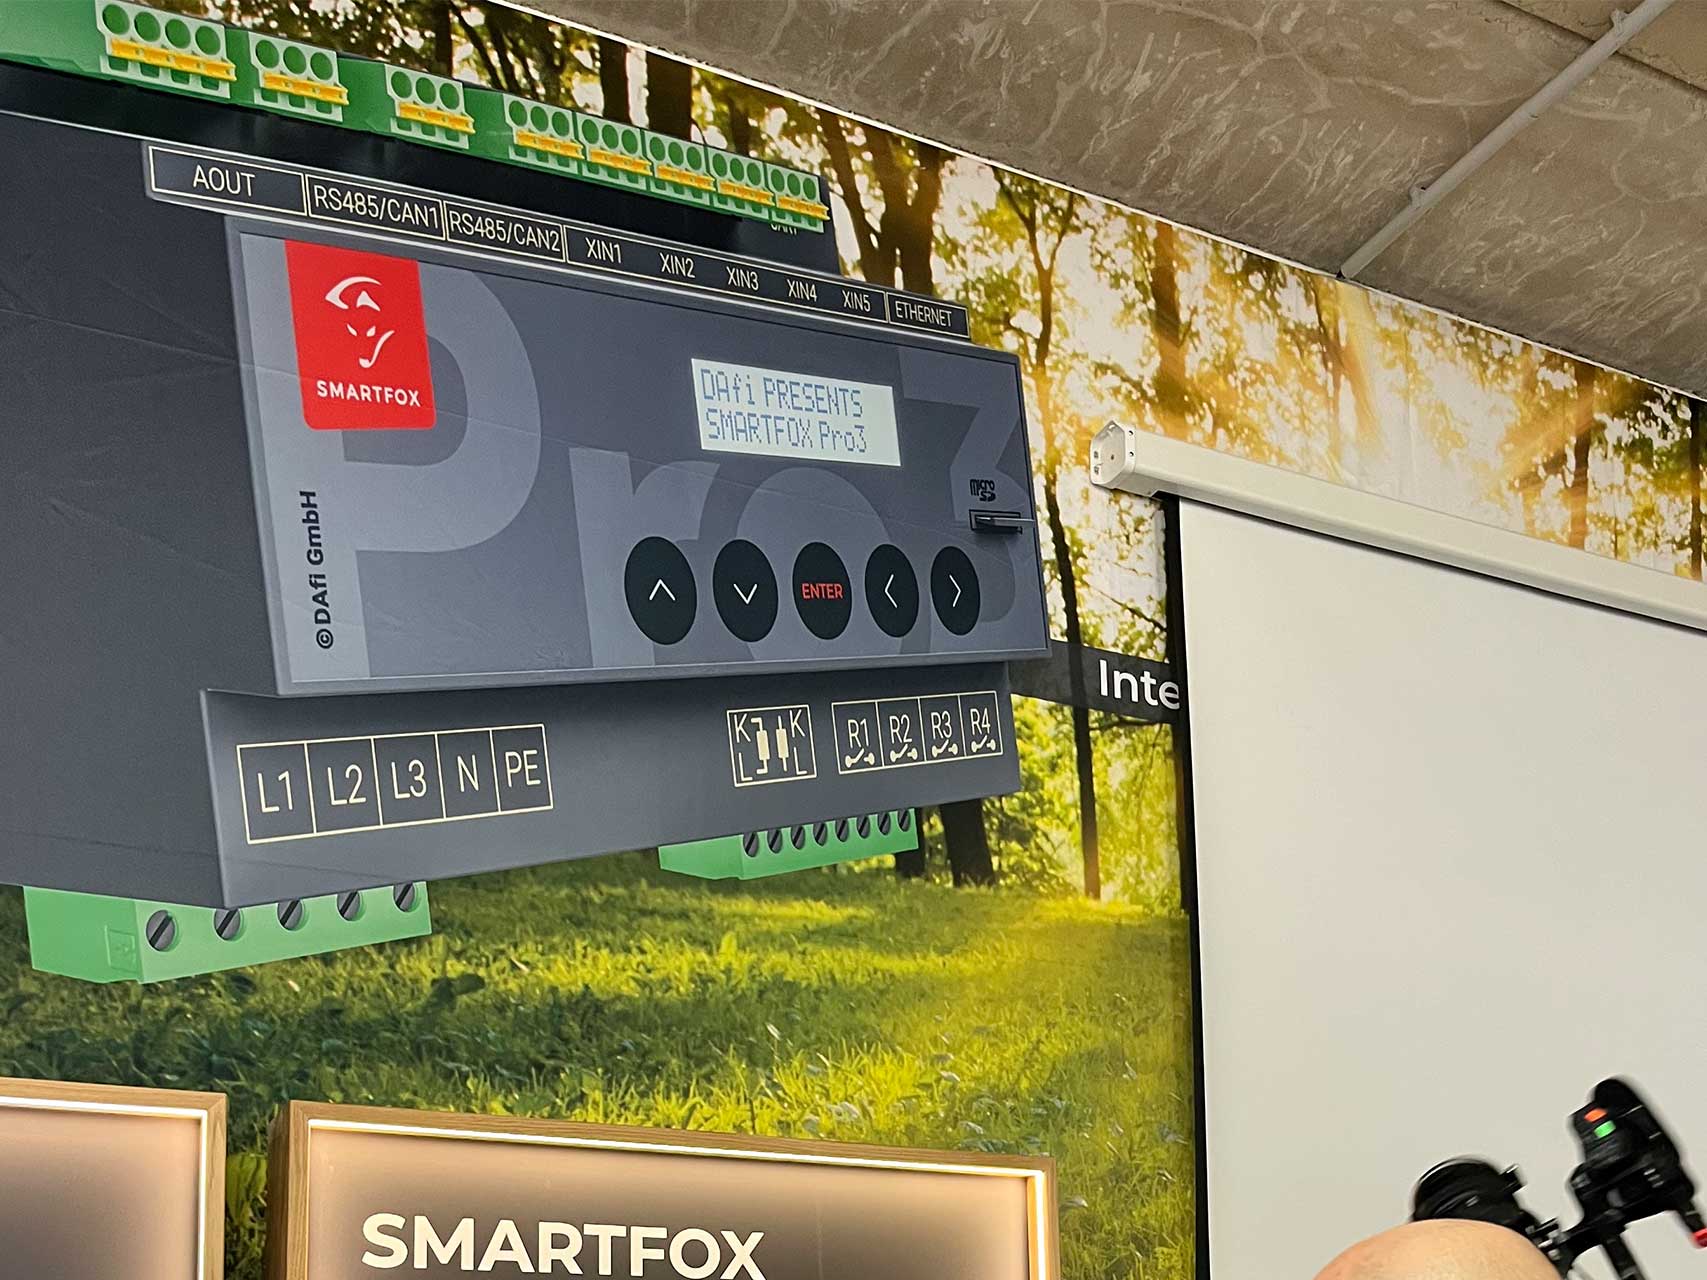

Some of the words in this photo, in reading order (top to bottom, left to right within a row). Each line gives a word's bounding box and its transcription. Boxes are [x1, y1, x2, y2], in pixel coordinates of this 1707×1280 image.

[192, 165, 256, 196] AOUT
[313, 185, 439, 230] RS485/CAN1
[449, 210, 560, 253] RS485/CAN2
[586, 236, 622, 264] XIN1
[660, 251, 695, 278] XIN2
[727, 265, 759, 291] XIN3
[787, 278, 817, 303] XIN4
[842, 289, 871, 312] XIN5
[895, 300, 951, 328] ETHERNET
[316, 380, 421, 407] SMARTFOX
[701, 368, 754, 406] DAfi
[763, 377, 864, 418] PRESENTS
[707, 409, 811, 447] SMARTFOX
[820, 421, 866, 453] Pro3
[299, 490, 325, 566] GmbH
[801, 583, 843, 600] ENTER
[1100, 660, 1180, 709] Inte
[848, 718, 869, 748] R1
[890, 714, 912, 743] R2
[930, 711, 952, 739] R3
[970, 707, 990, 735] R4
[257, 770, 293, 812] L1
[328, 764, 365, 804] L2
[391, 759, 427, 800] L3
[457, 755, 481, 793] N
[505, 749, 540, 788] PE
